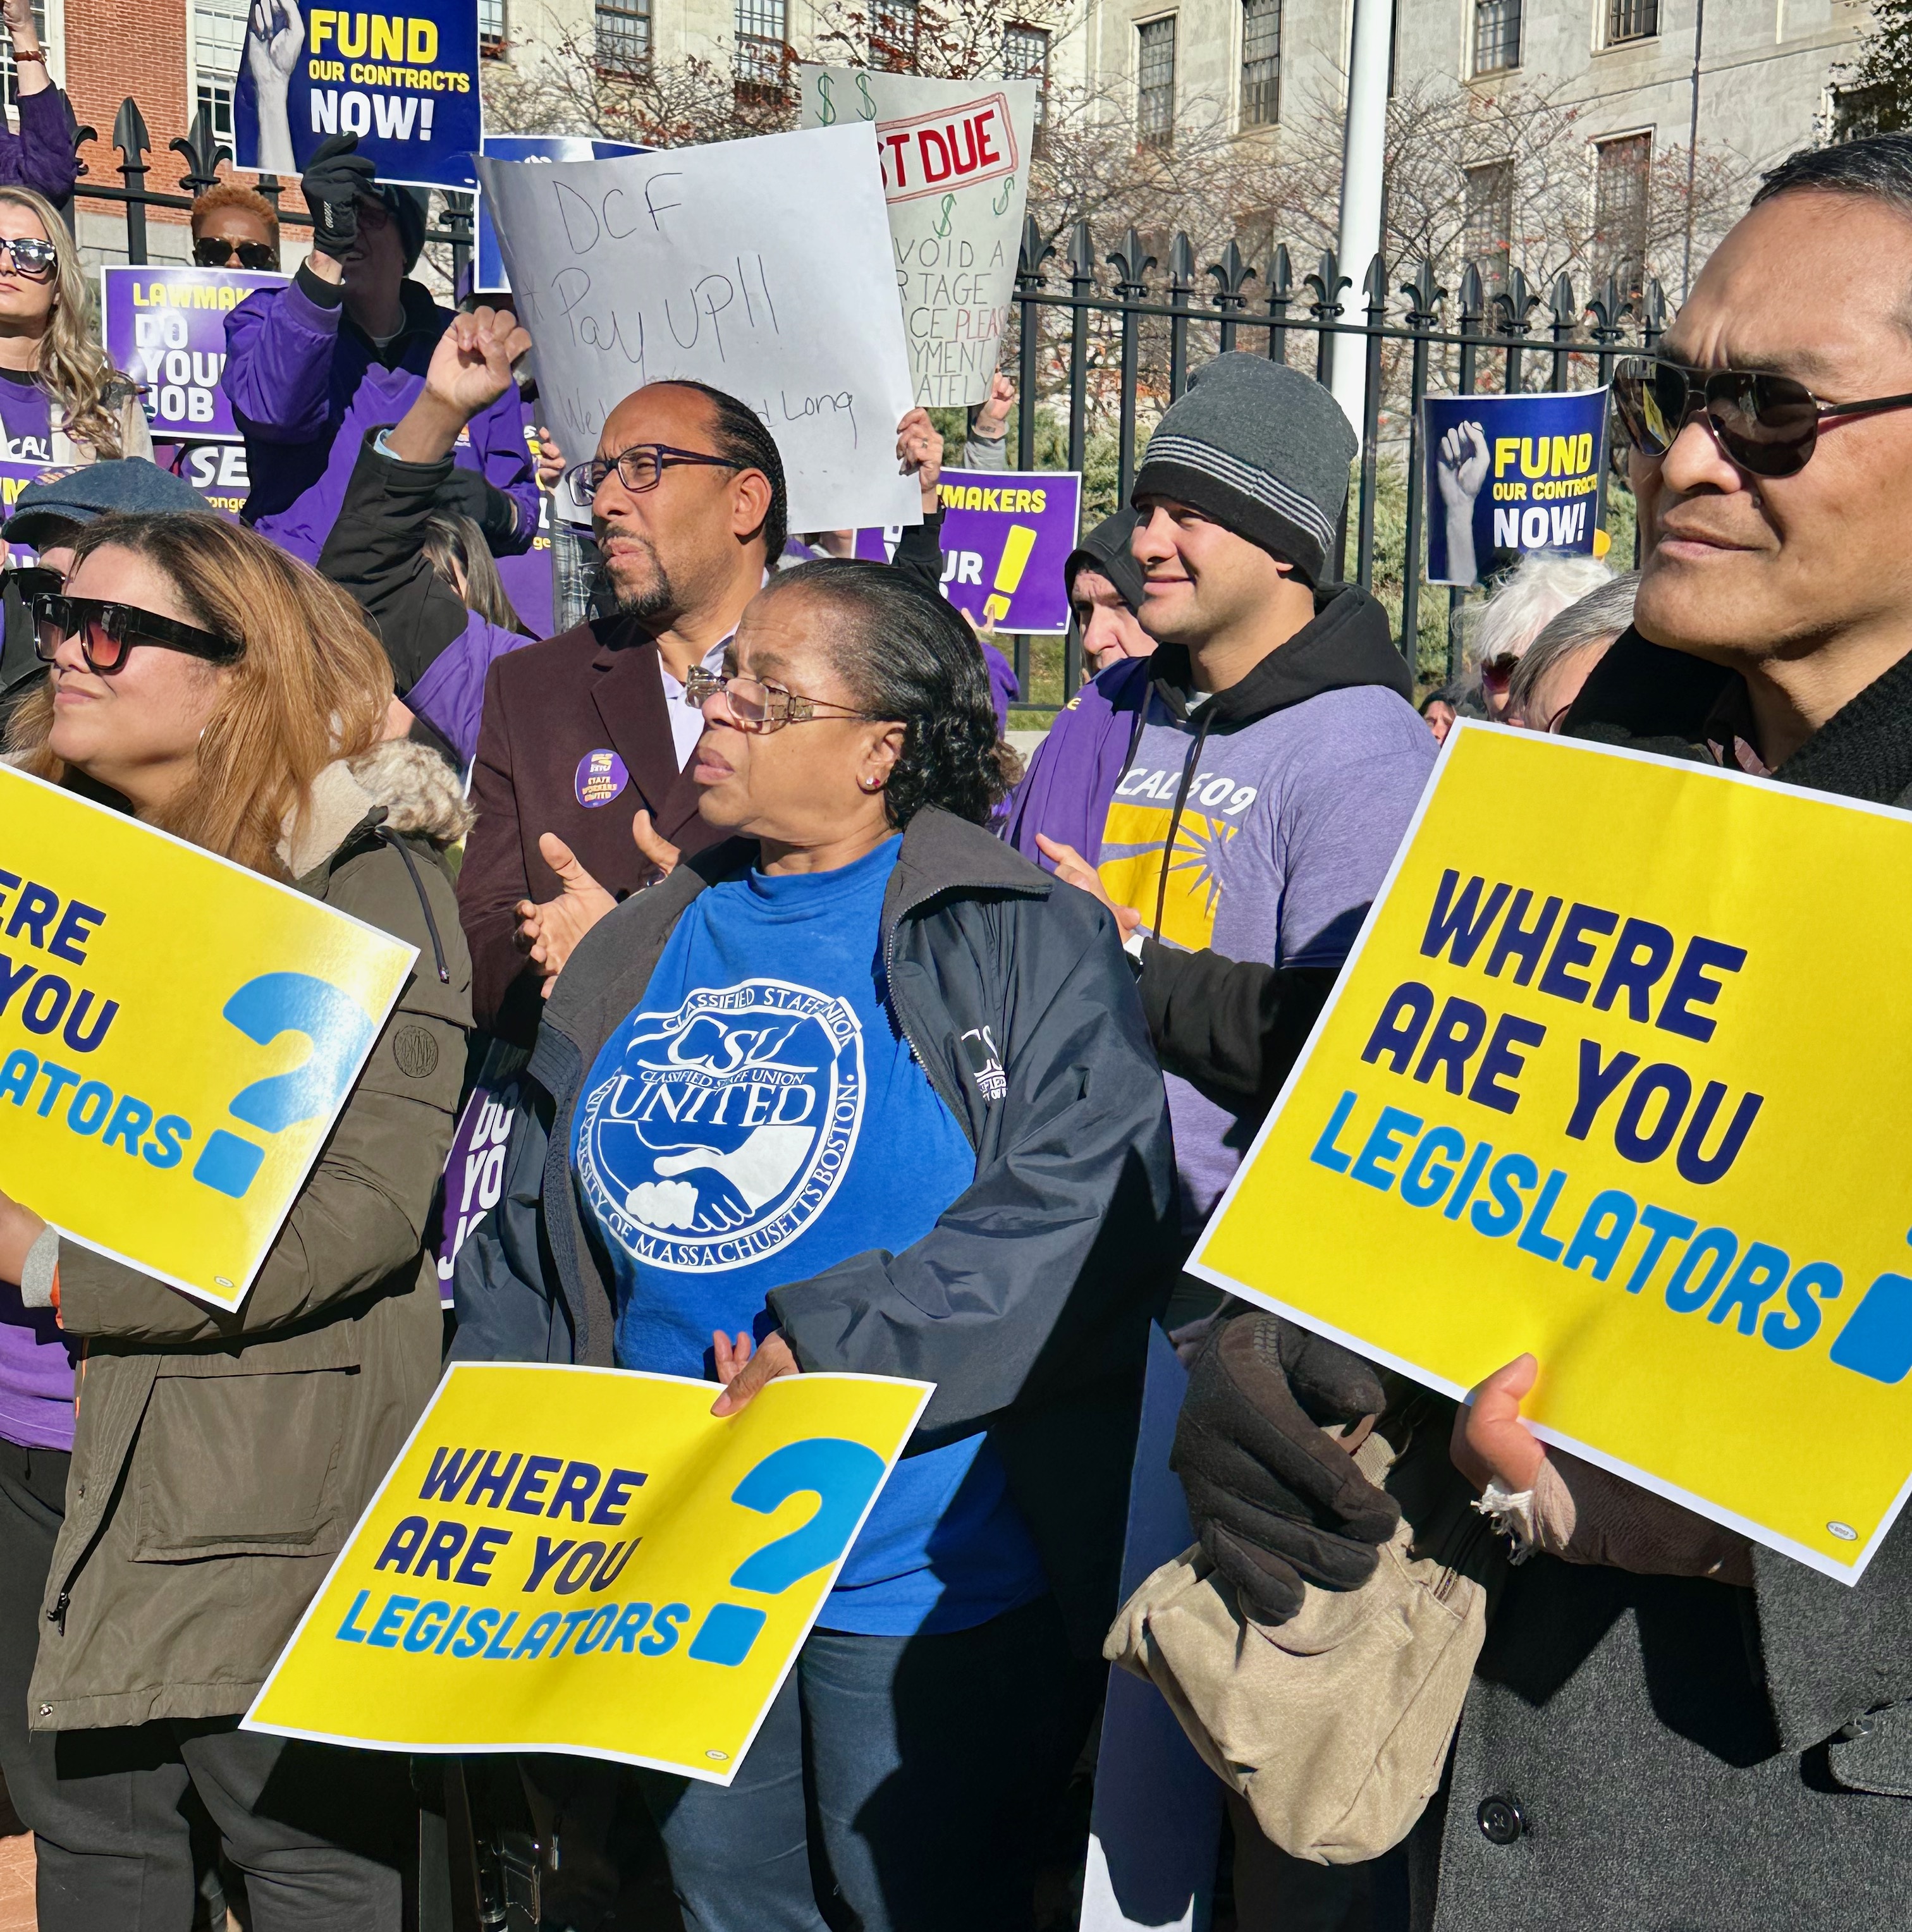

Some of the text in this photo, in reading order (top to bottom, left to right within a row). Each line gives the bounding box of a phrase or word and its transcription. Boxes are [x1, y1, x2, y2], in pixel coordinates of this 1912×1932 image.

[310, 9, 438, 64] FUND
[309, 59, 470, 93] OUR CONTRACTS
[310, 89, 434, 141] NOW!
[917, 109, 1000, 183] DUE
[553, 173, 683, 254] DCF
[990, 240, 1004, 267] A
[135, 314, 188, 349] DO
[551, 267, 646, 386] Pay
[138, 348, 226, 387] YOU
[780, 389, 857, 450] Long
[1495, 433, 1593, 479] FUND
[936, 484, 1046, 513] MAKERS
[1493, 482, 1527, 501] OUR
[1494, 502, 1586, 548] NOW!
[1419, 867, 1748, 1043] WHERE
[764, 988, 824, 1013] STAFF
[667, 1015, 802, 1071] CSU
[610, 1074, 816, 1127] UNITED
[640, 1070, 713, 1087] CLASSIFIED
[752, 1070, 806, 1085] UNION
[1361, 981, 1764, 1185] ARE YOU
[0, 1049, 192, 1169] ATORS
[609, 1213, 632, 1237] OF
[635, 1184, 823, 1267] MASSACHUSETTS
[1309, 1089, 1844, 1350] LEGISLATORS
[418, 1446, 649, 1525] WHERE
[375, 1516, 641, 1595] ARE YOU
[336, 1589, 691, 1661] LEGISLATORS
